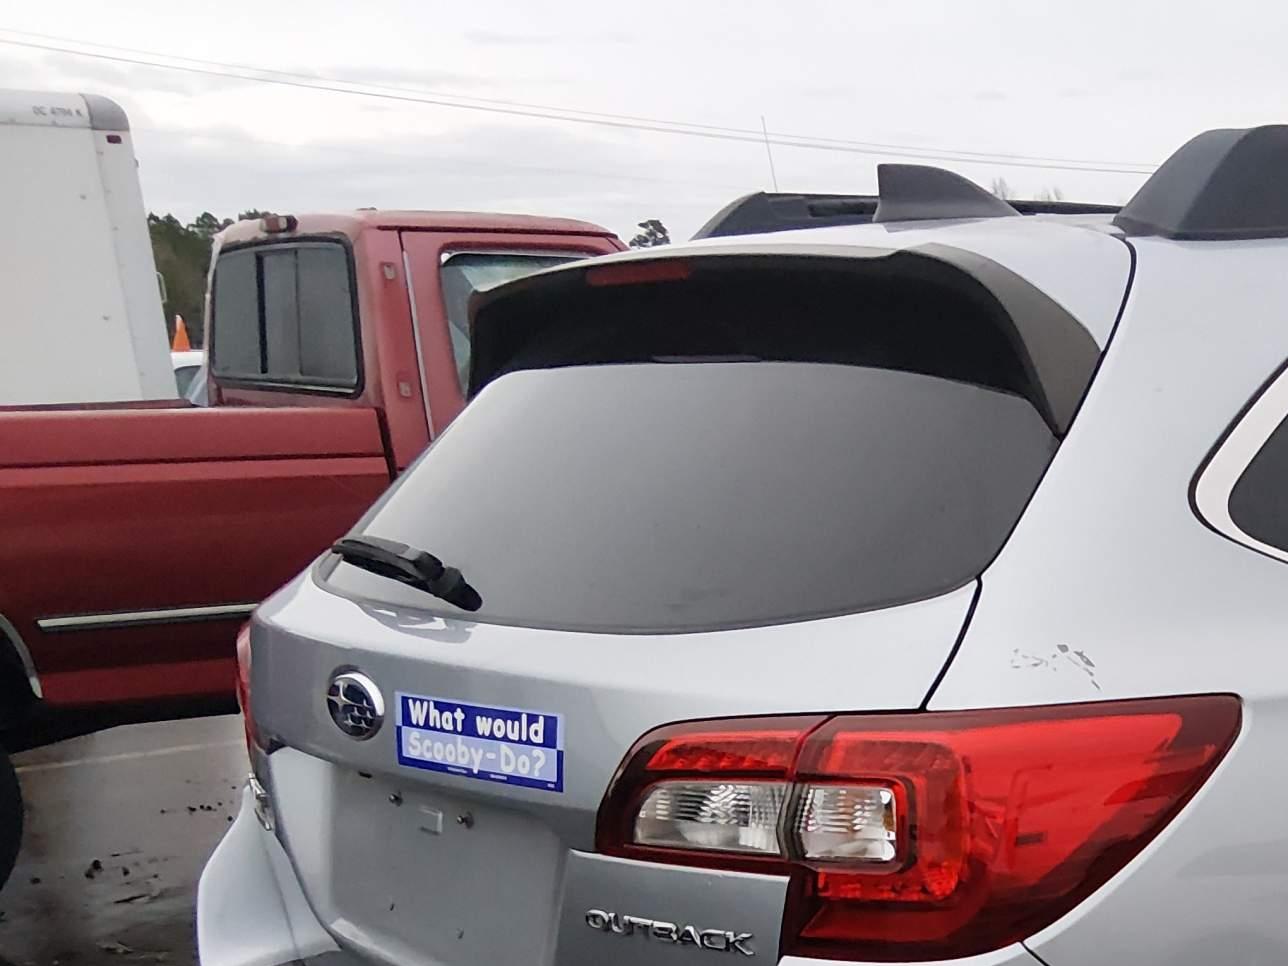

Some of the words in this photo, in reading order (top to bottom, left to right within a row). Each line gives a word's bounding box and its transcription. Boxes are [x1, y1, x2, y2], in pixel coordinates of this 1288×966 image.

[407, 698, 466, 732] What
[475, 713, 544, 744] would
[407, 731, 546, 777] Scooby-Do?
[585, 908, 756, 957] OUTBACK
